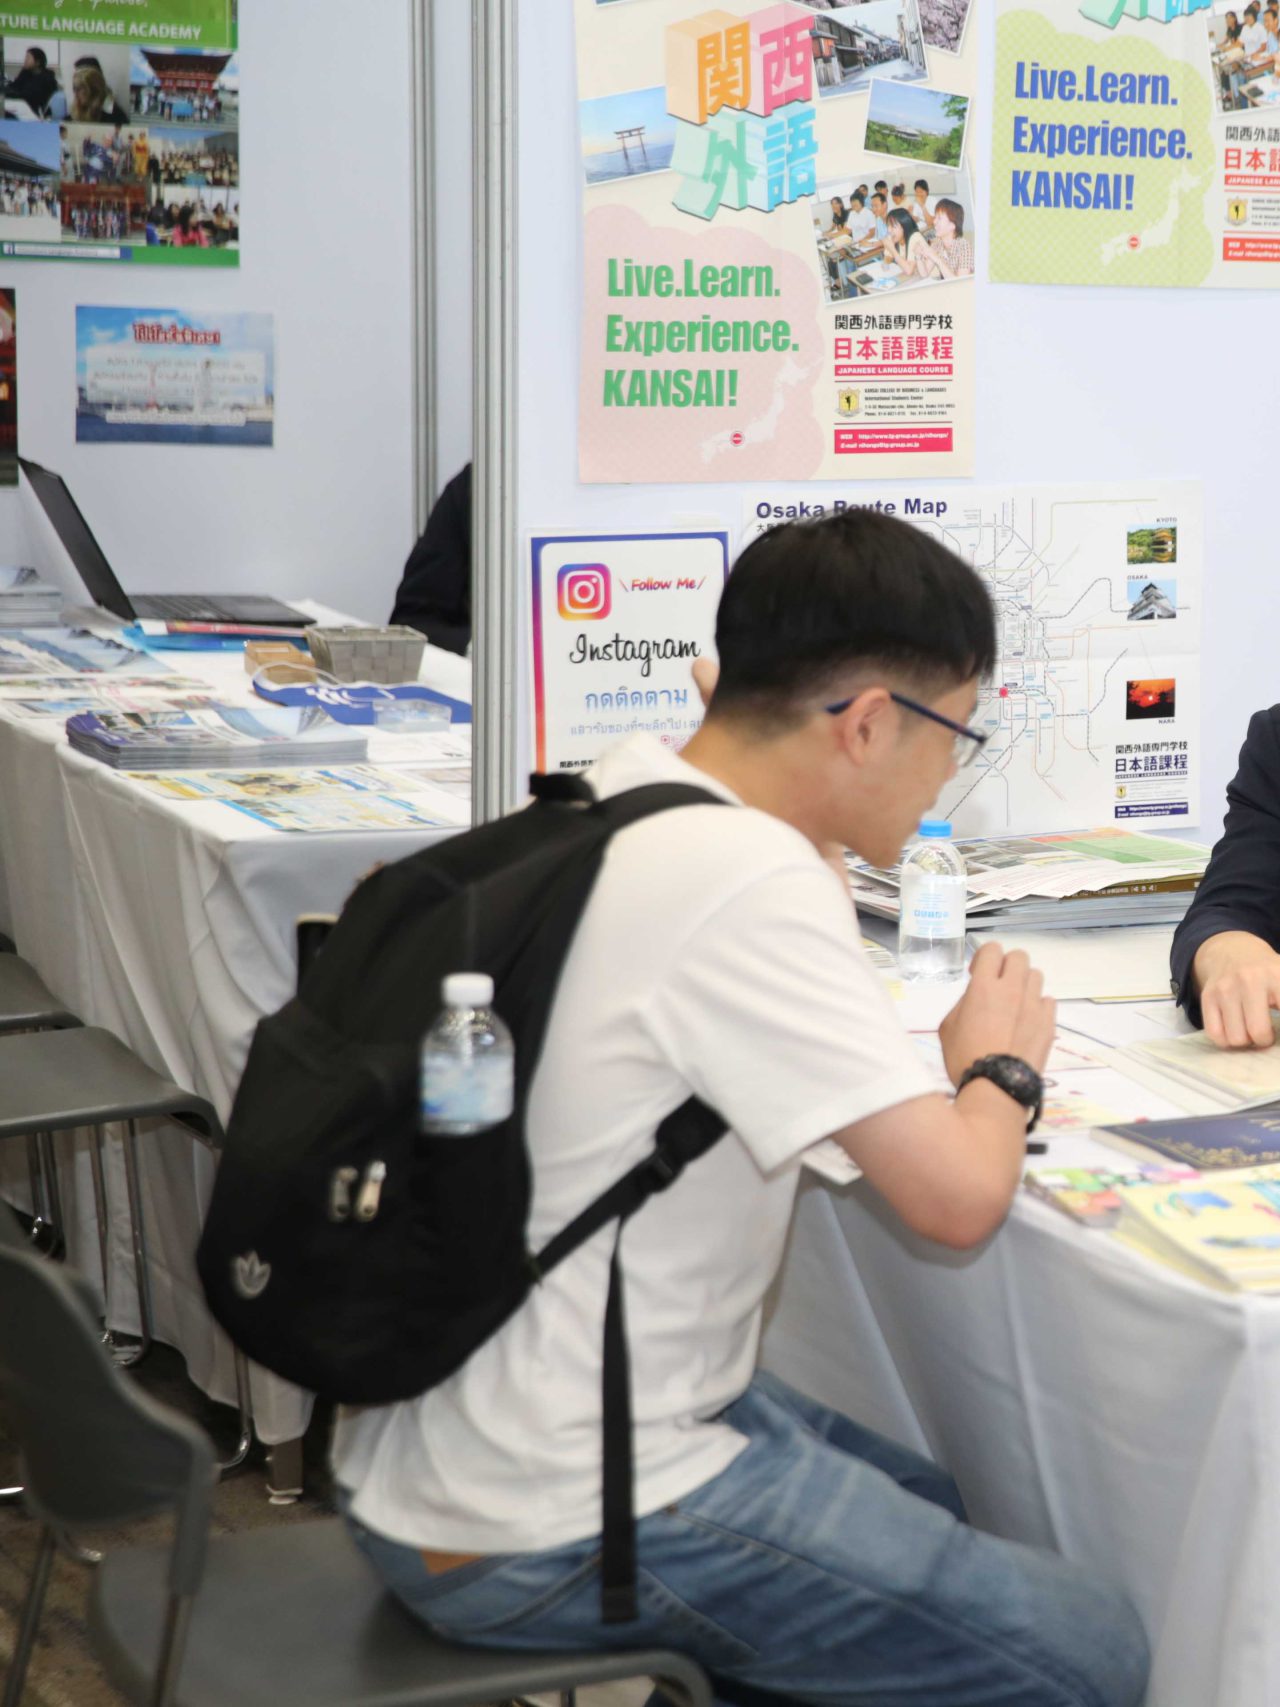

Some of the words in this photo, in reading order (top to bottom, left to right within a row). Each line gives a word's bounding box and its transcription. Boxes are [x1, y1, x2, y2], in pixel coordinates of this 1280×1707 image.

[42, 17, 125, 36] LANGUAGE
[129, 21, 201, 41] ACADEMY
[678, 6, 815, 125] 関西
[1014, 61, 1178, 106] Live.Learn.
[1012, 115, 1193, 160] Experience.
[685, 104, 819, 221] 外語
[1011, 170, 1135, 211] KANSAI!
[605, 258, 781, 299] Live.Learn.
[605, 314, 800, 357] Experience.
[834, 314, 953, 330] 関西外語専門学校
[834, 335, 954, 360] 日本語課程
[602, 368, 738, 408] KANSAI!
[838, 366, 876, 374] JAPANESE
[878, 366, 917, 374] LANGUAGE
[919, 365, 949, 373] COURSE
[756, 501, 826, 519] Osaka
[904, 497, 948, 518] Map
[631, 577, 672, 592] Follow
[676, 577, 697, 590] Me
[568, 632, 702, 677] Instagram
[585, 686, 688, 710] กดติดตาม
[1115, 754, 1188, 772] 日本語課程
